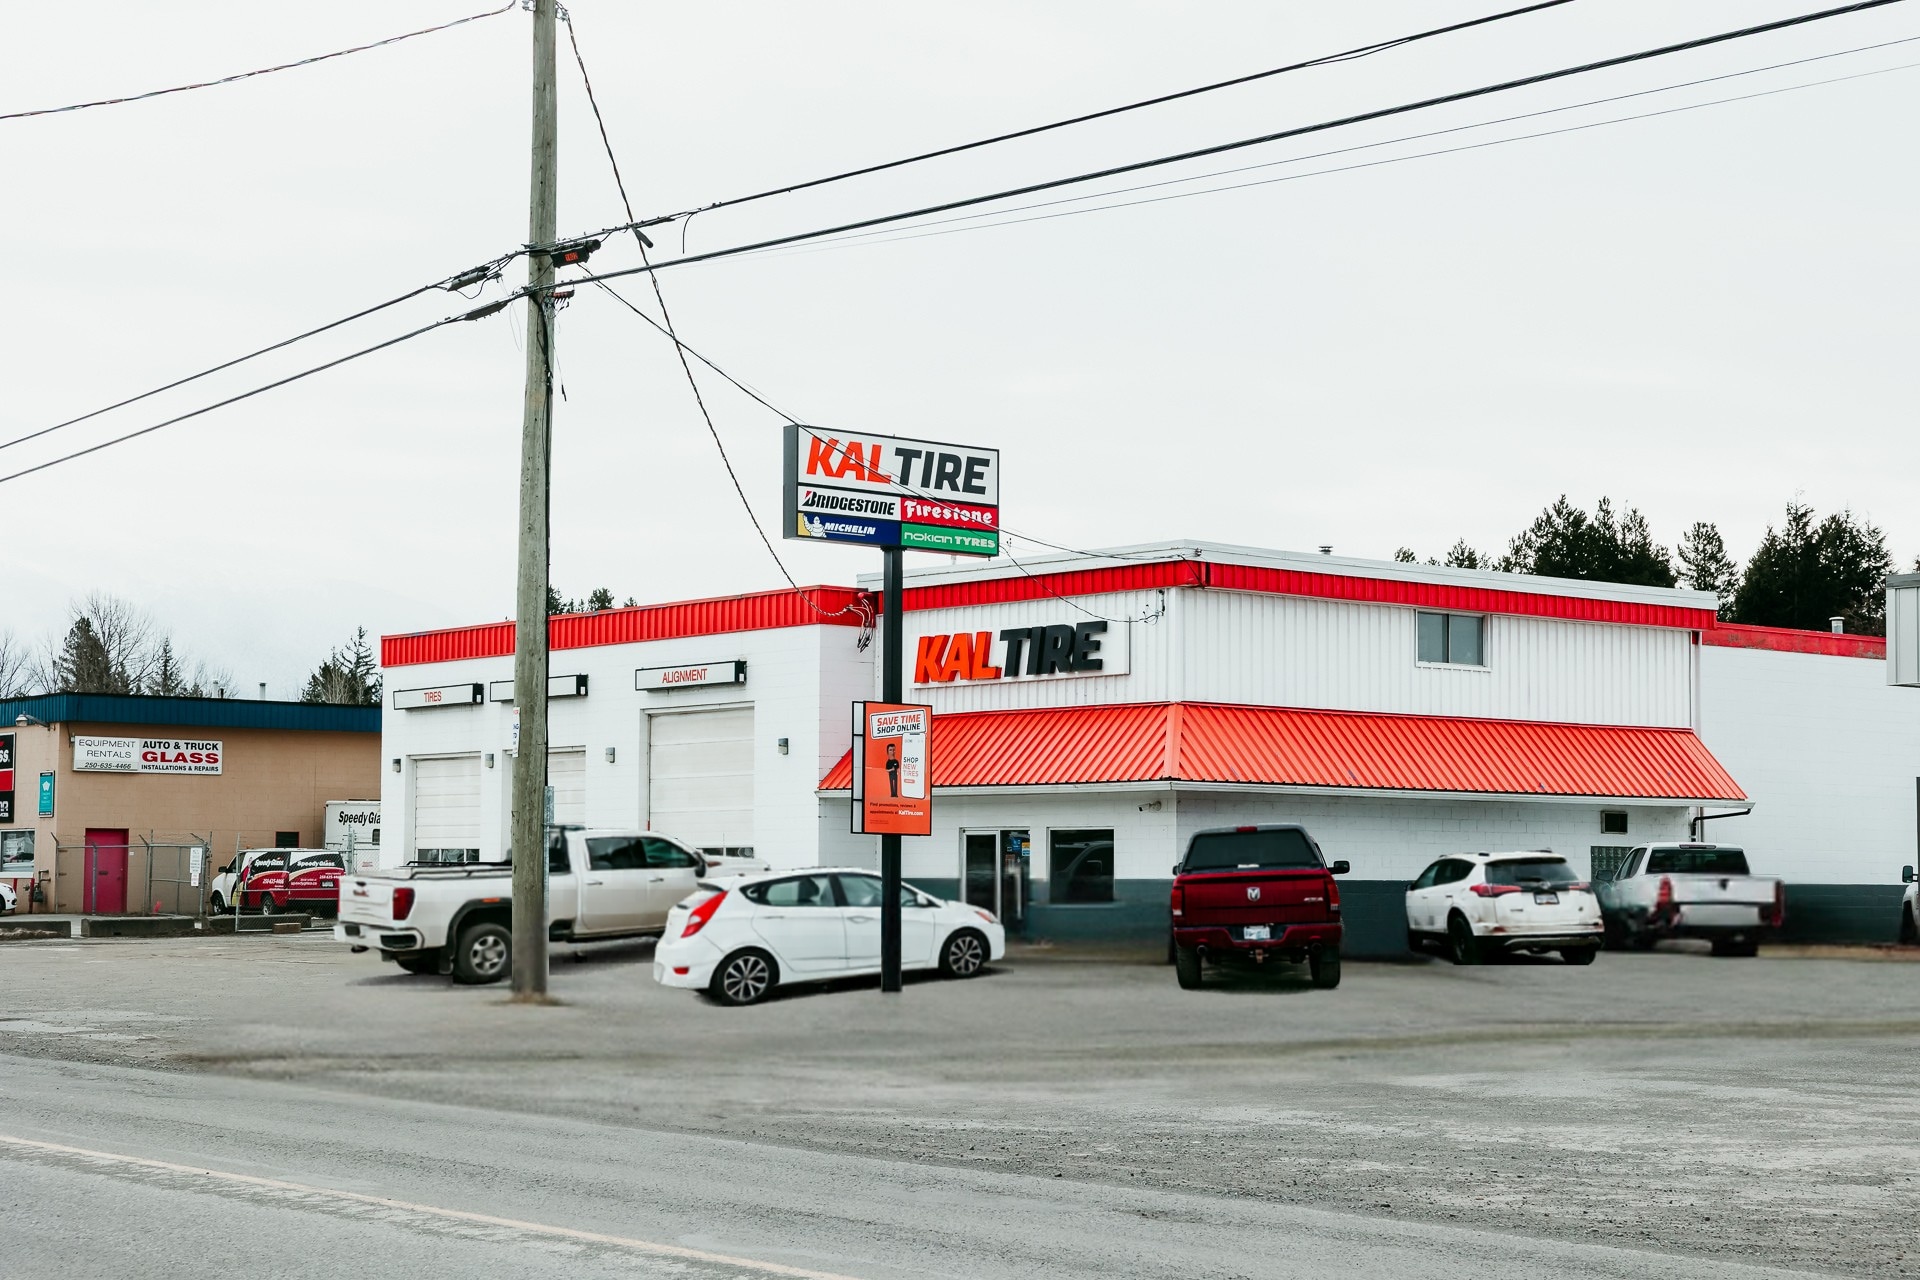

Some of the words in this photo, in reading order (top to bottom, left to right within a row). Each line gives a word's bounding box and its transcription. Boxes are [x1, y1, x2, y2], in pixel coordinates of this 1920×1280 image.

[802, 490, 896, 516] BRIDGESTONE
[904, 500, 993, 524] Firestone
[824, 522, 876, 535] MICHELIN
[954, 537, 996, 549] TYRES
[662, 668, 708, 684] ALIGNMENT
[424, 690, 442, 702] TIRES
[877, 716, 899, 727] SAVE
[901, 714, 921, 725] TIME
[877, 725, 896, 735] SHOP
[896, 723, 921, 732] ONLINE
[78, 739, 136, 748] EQUIPMENT
[142, 741, 170, 750] AUTO
[173, 741, 181, 750] &
[184, 742, 219, 751] TRUCK
[86, 750, 132, 758] RENTALS
[141, 751, 219, 764] GLASS
[84, 762, 132, 770] 250-635-4466
[338, 811, 368, 826] Speedy
